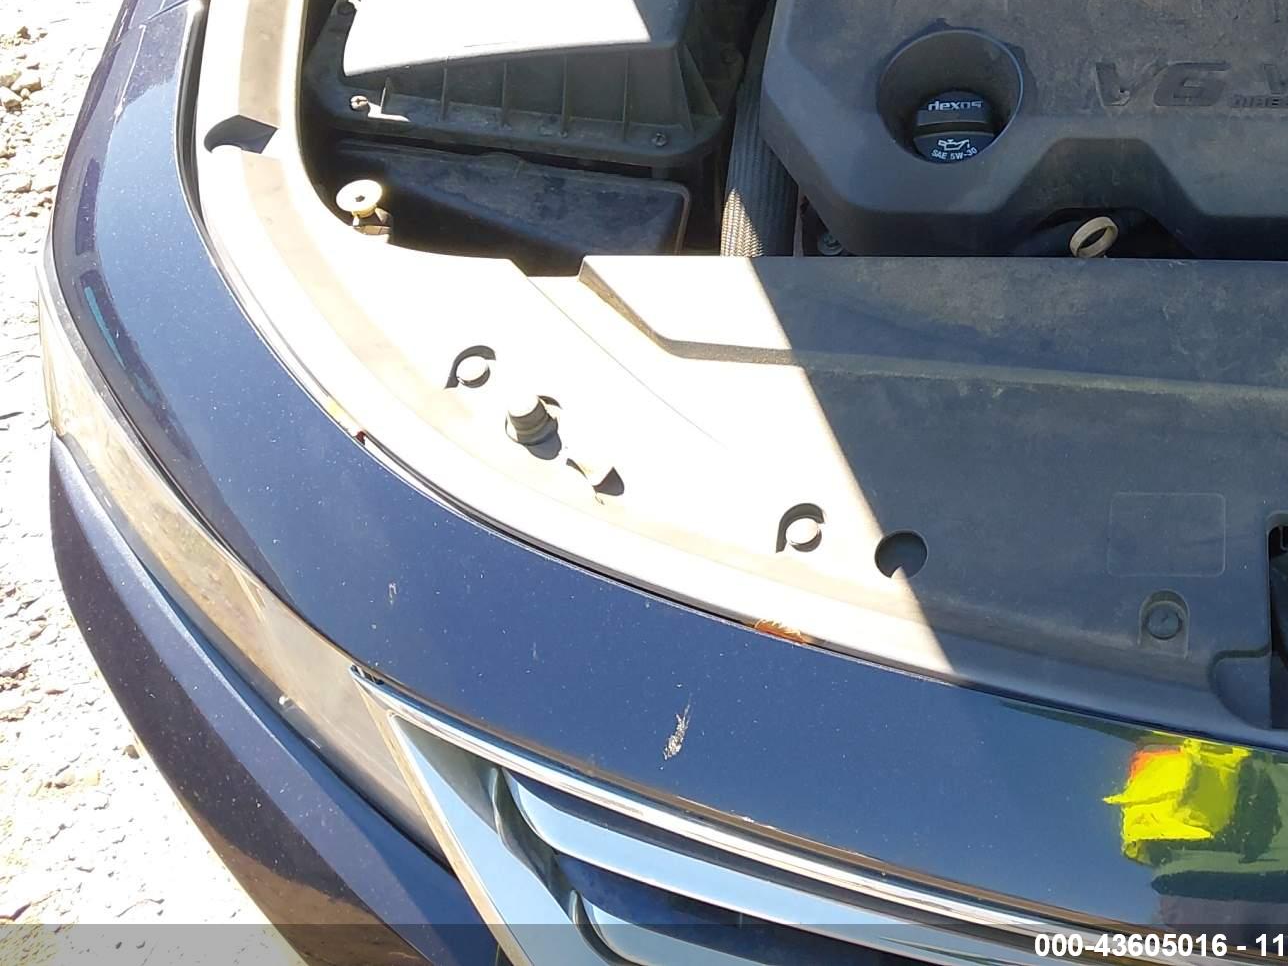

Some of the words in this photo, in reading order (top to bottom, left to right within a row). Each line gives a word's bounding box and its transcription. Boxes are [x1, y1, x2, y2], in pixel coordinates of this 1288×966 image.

[1094, 61, 1233, 107] V6
[928, 100, 984, 111] dexos
[931, 149, 948, 160] SAE
[950, 147, 978, 160] 5W-30
